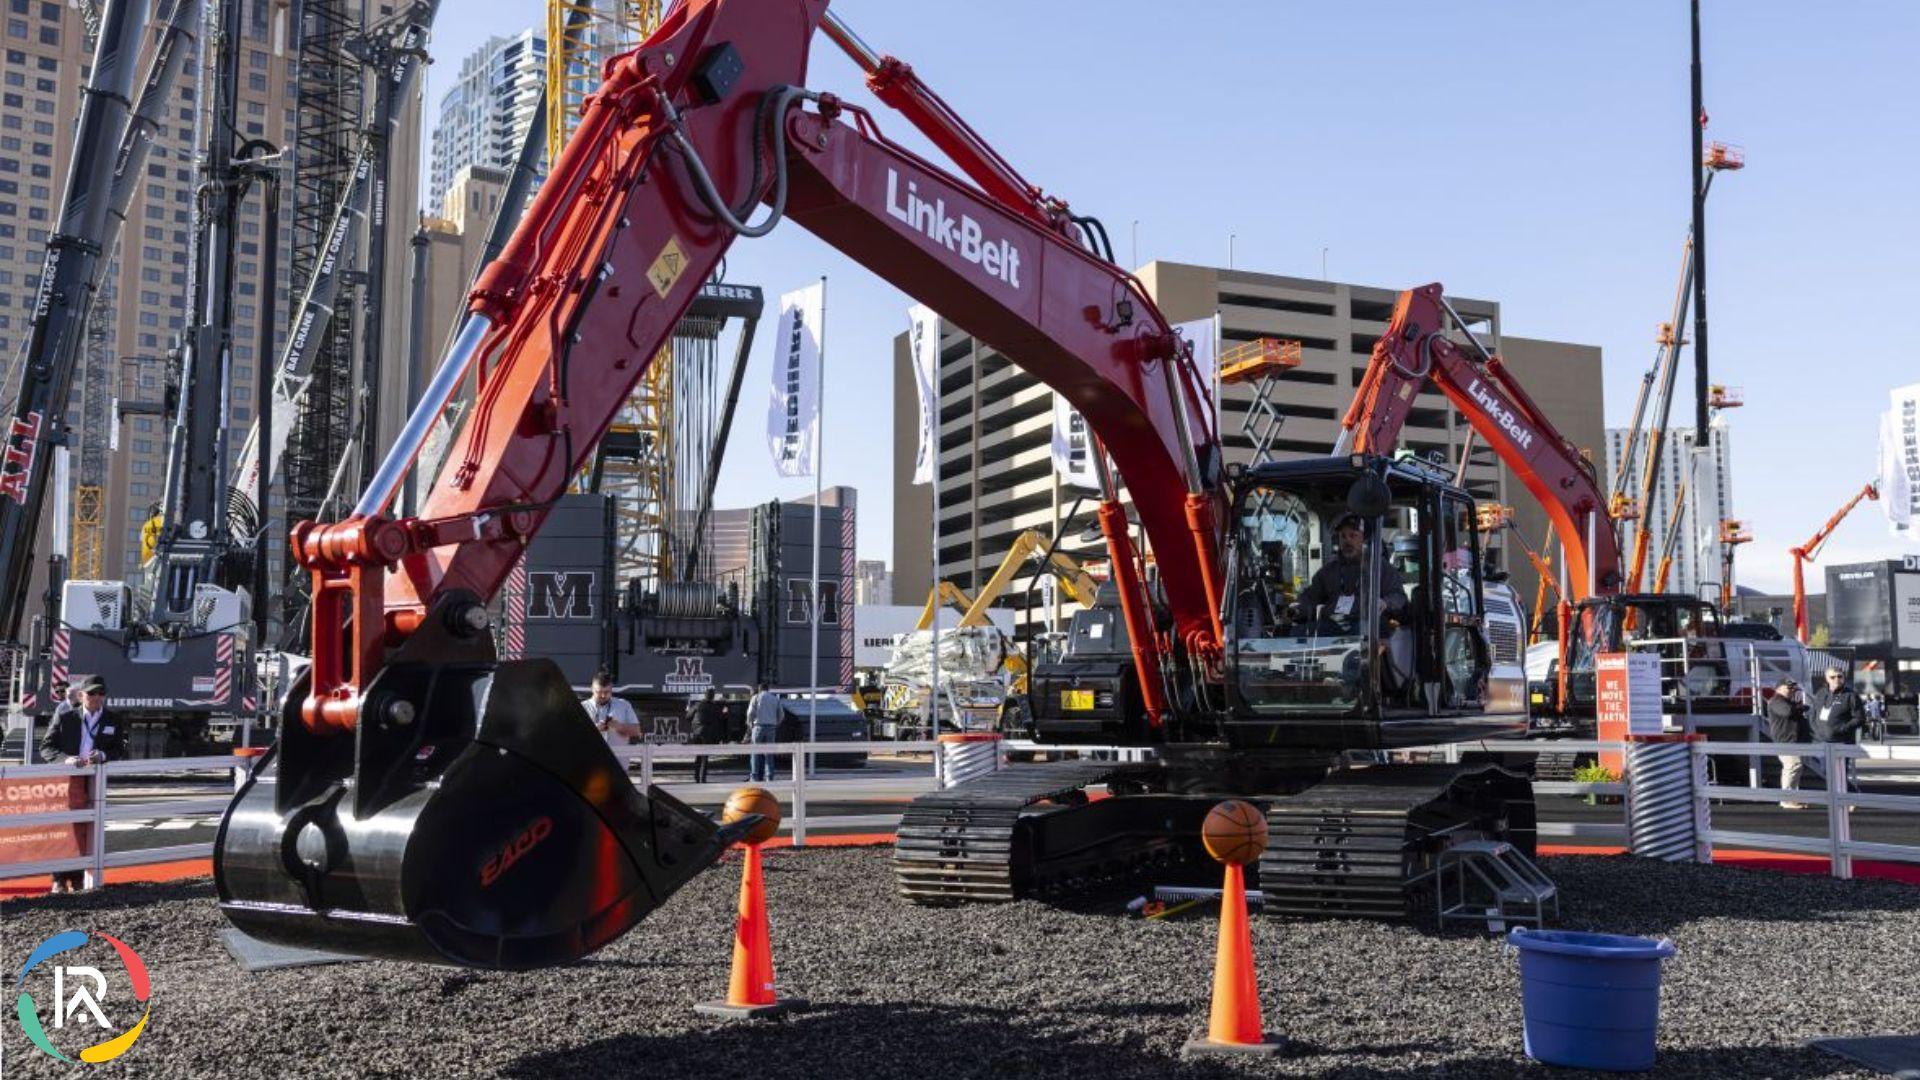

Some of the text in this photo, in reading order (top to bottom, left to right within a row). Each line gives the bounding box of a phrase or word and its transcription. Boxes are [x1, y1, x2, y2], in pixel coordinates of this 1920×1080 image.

[321, 215, 349, 275] BAY CRANE
[886, 167, 1020, 289] Link-Belt
[286, 311, 315, 372] BAY CRANE
[1467, 378, 1533, 450] Link-Belt
[0, 411, 42, 505] ALL
[527, 571, 595, 619] M
[787, 578, 840, 625] M
[107, 698, 173, 708] LIEBHERR
[1600, 690, 1624, 700] MOVE
[1605, 680, 1619, 690] WE
[1605, 701, 1622, 711] THE
